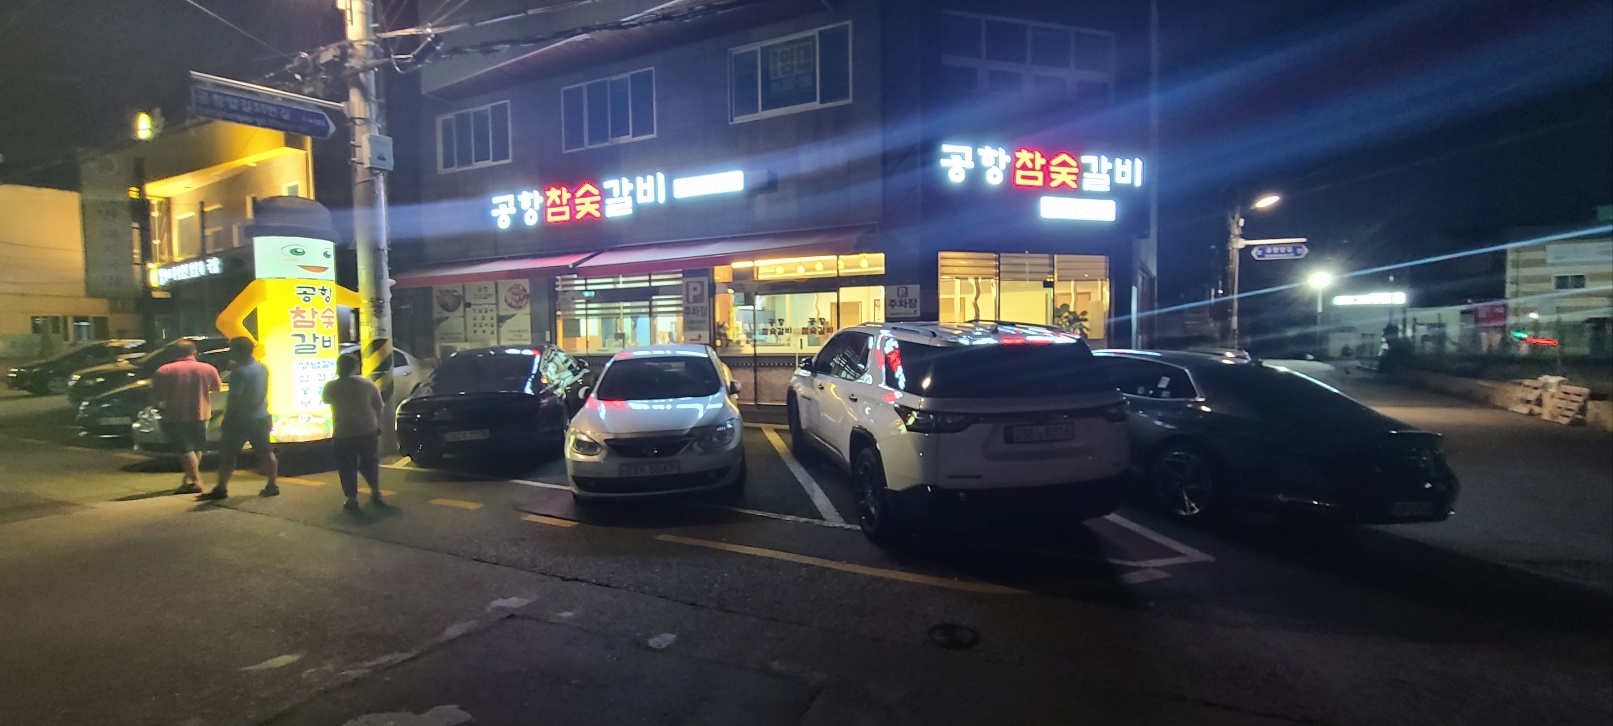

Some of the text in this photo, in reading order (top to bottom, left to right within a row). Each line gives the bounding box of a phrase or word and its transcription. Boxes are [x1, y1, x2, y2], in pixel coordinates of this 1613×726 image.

[296, 285, 333, 303] 공항
[684, 306, 708, 317] 주차장
[889, 298, 918, 309] 주차장
[289, 306, 335, 329] 참숯
[291, 333, 337, 355] 갈비
